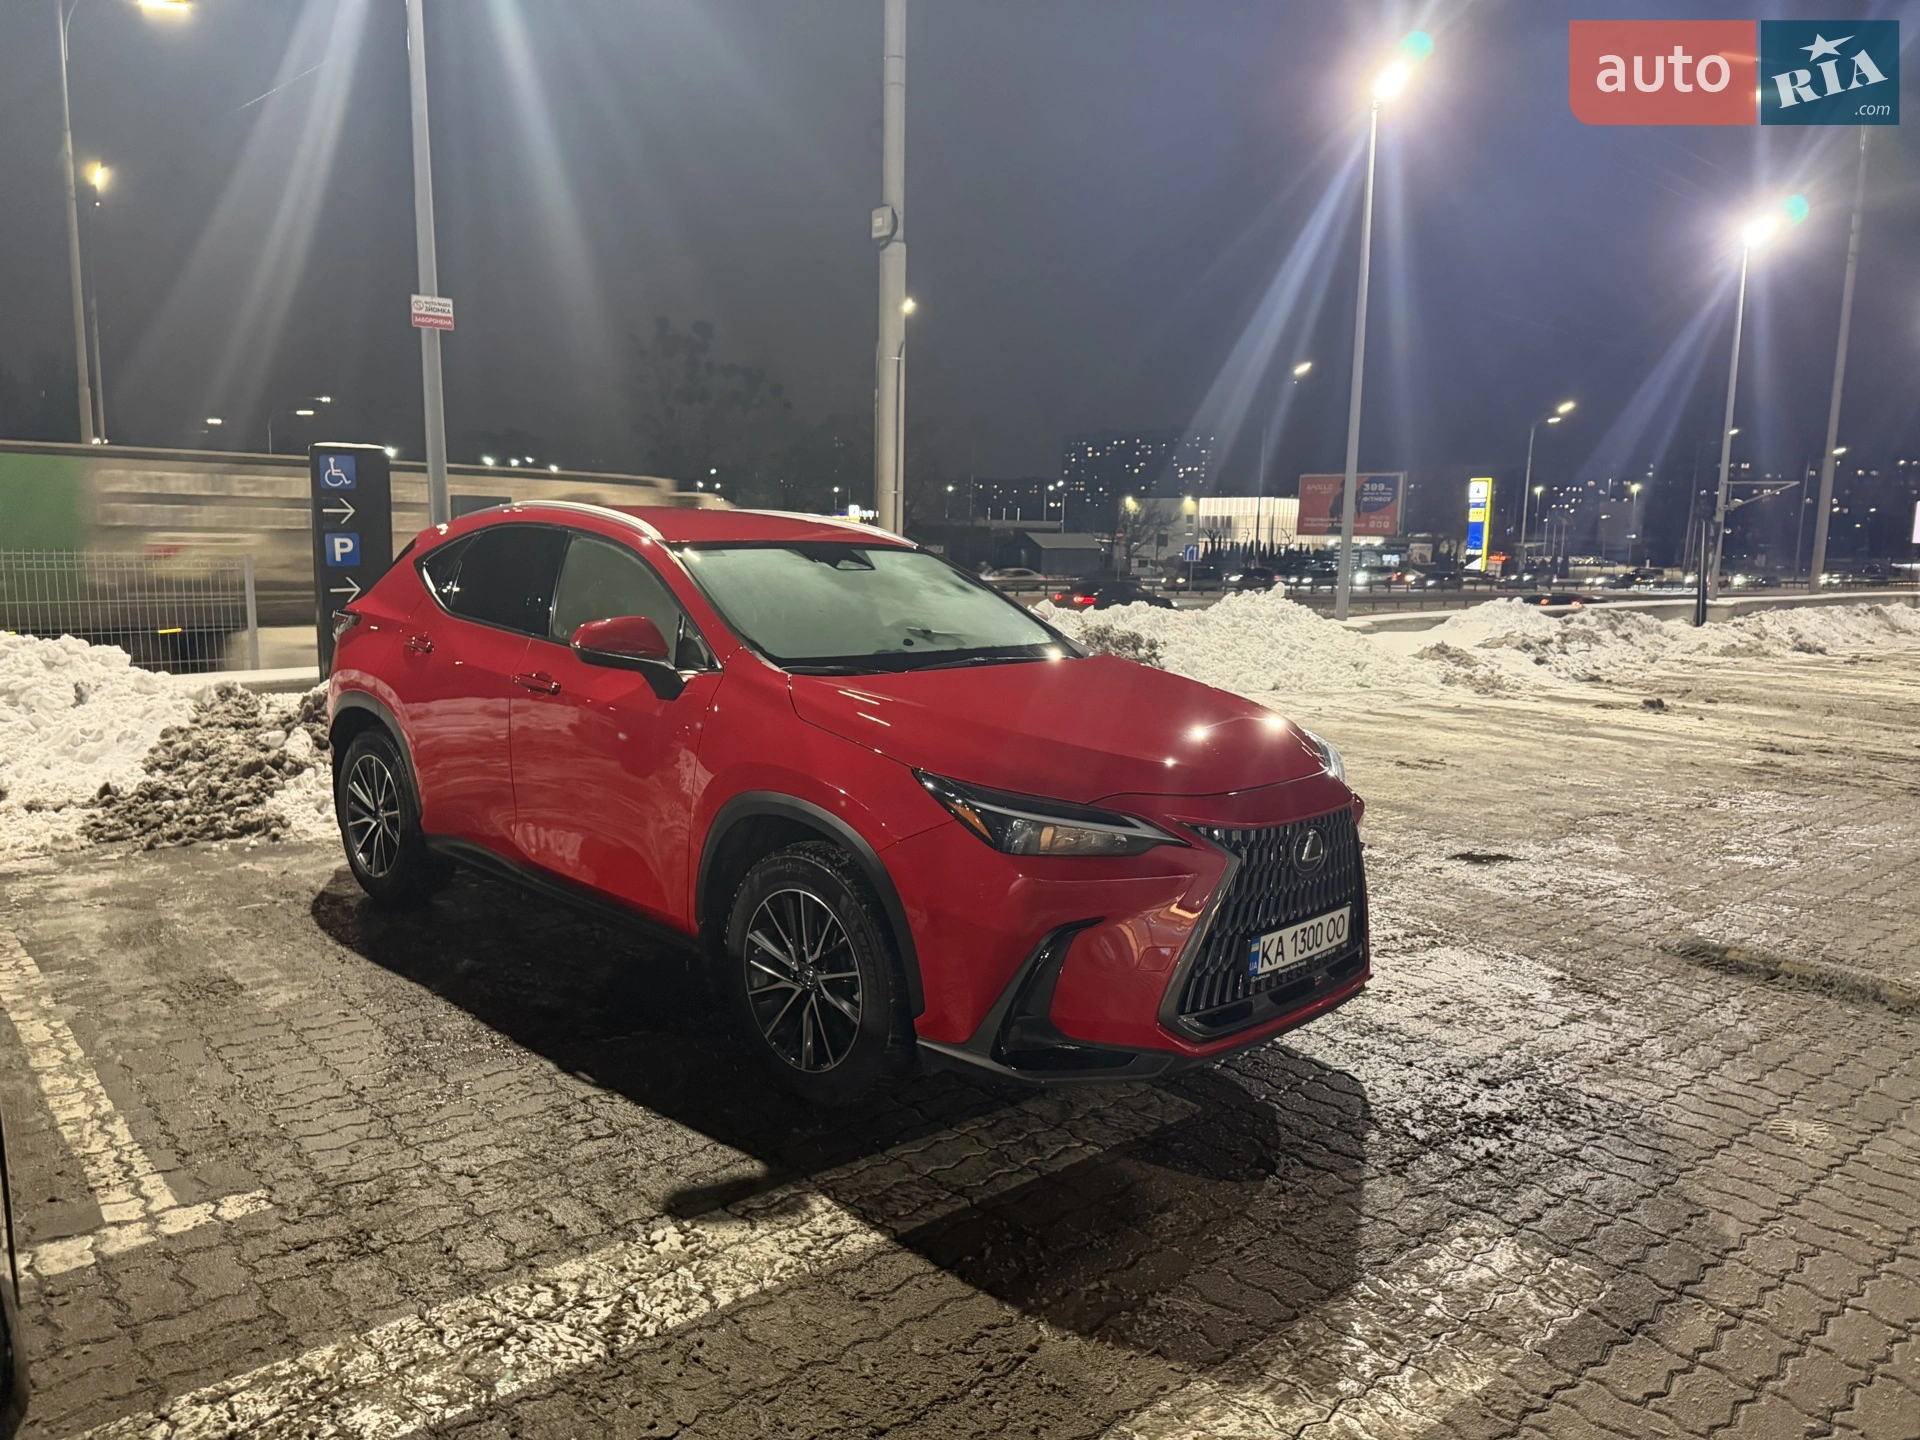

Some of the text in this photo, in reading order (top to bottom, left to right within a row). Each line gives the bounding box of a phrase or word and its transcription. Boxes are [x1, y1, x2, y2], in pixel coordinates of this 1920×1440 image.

[424, 305, 451, 314] ЗЙОМКА
[334, 538, 354, 562] P
[1260, 936, 1285, 968] KA
[1291, 922, 1323, 957] 1300
[1250, 961, 1258, 971] UA
